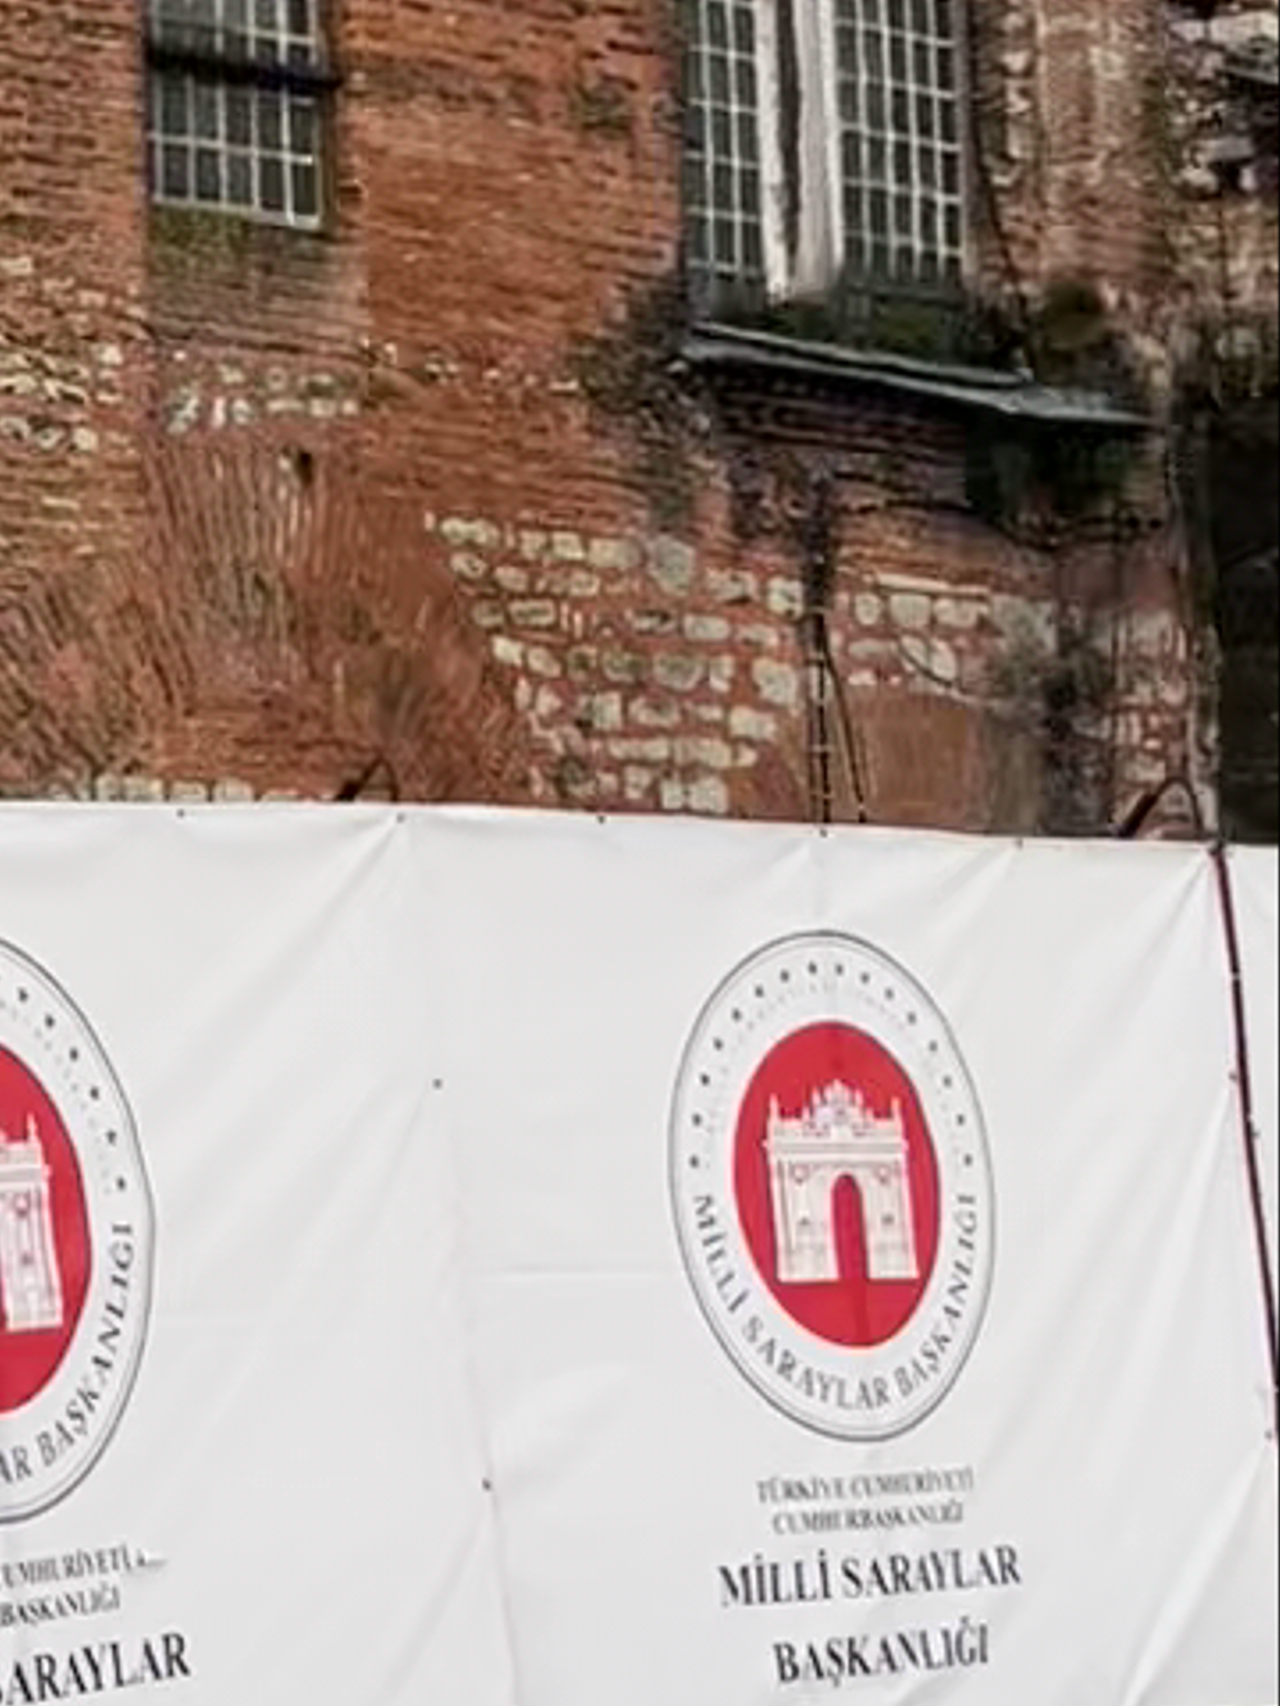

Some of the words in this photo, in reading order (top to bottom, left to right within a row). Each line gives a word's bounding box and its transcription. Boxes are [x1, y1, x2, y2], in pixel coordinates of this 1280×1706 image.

[742, 1315, 890, 1410] SARAYLAR
[718, 1548, 832, 1608] MİLLİ
[840, 1544, 1021, 1599] SARAYLAR
[773, 1615, 989, 1688] BAŞKANLIĞI
